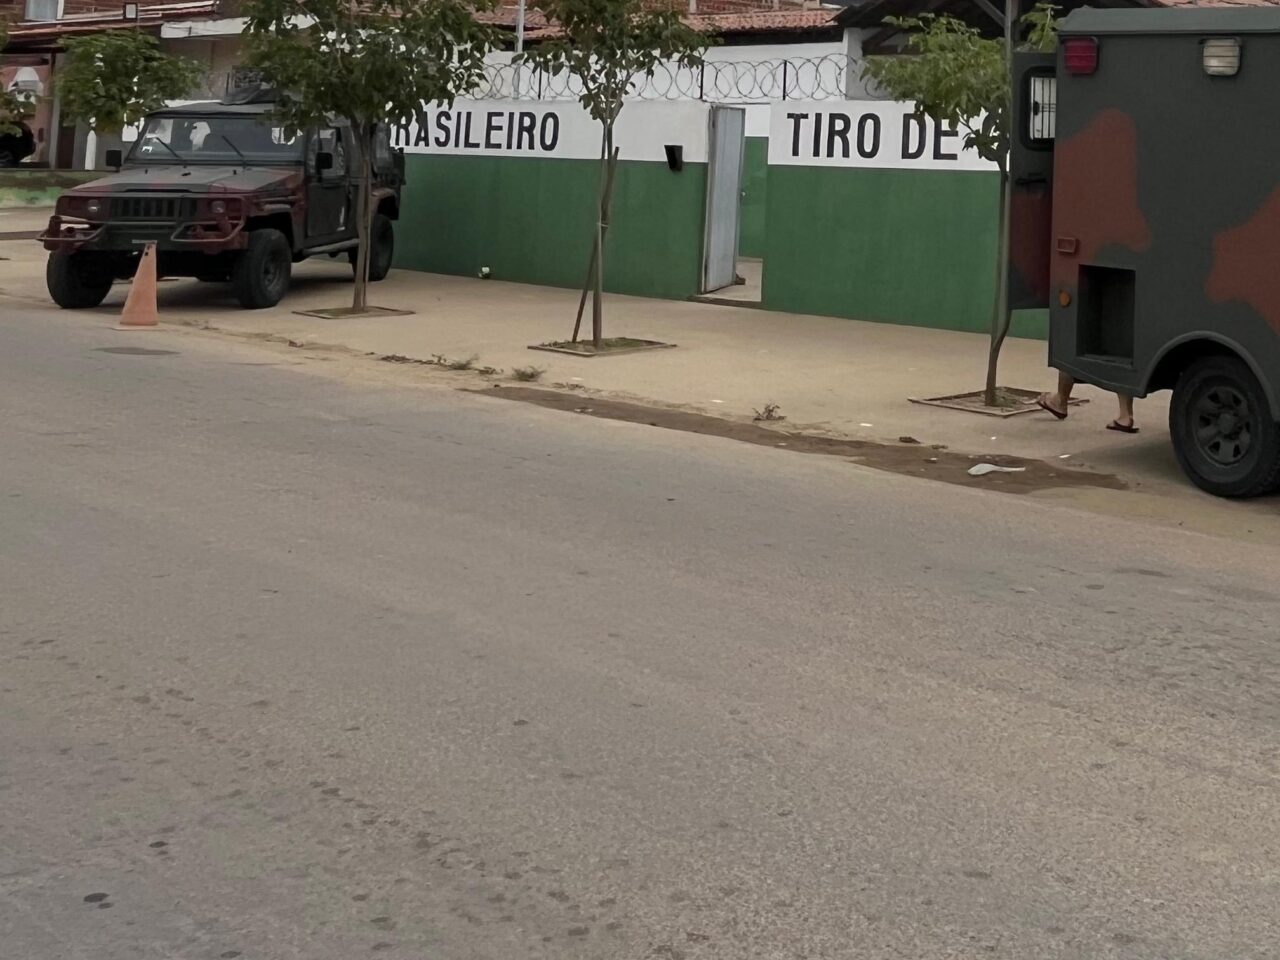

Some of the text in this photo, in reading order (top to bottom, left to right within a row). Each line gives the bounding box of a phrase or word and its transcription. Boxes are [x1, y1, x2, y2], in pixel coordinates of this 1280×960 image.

[391, 110, 560, 151] RASILEIRO
[787, 112, 881, 159] TIRO
[901, 113, 959, 160] DE
